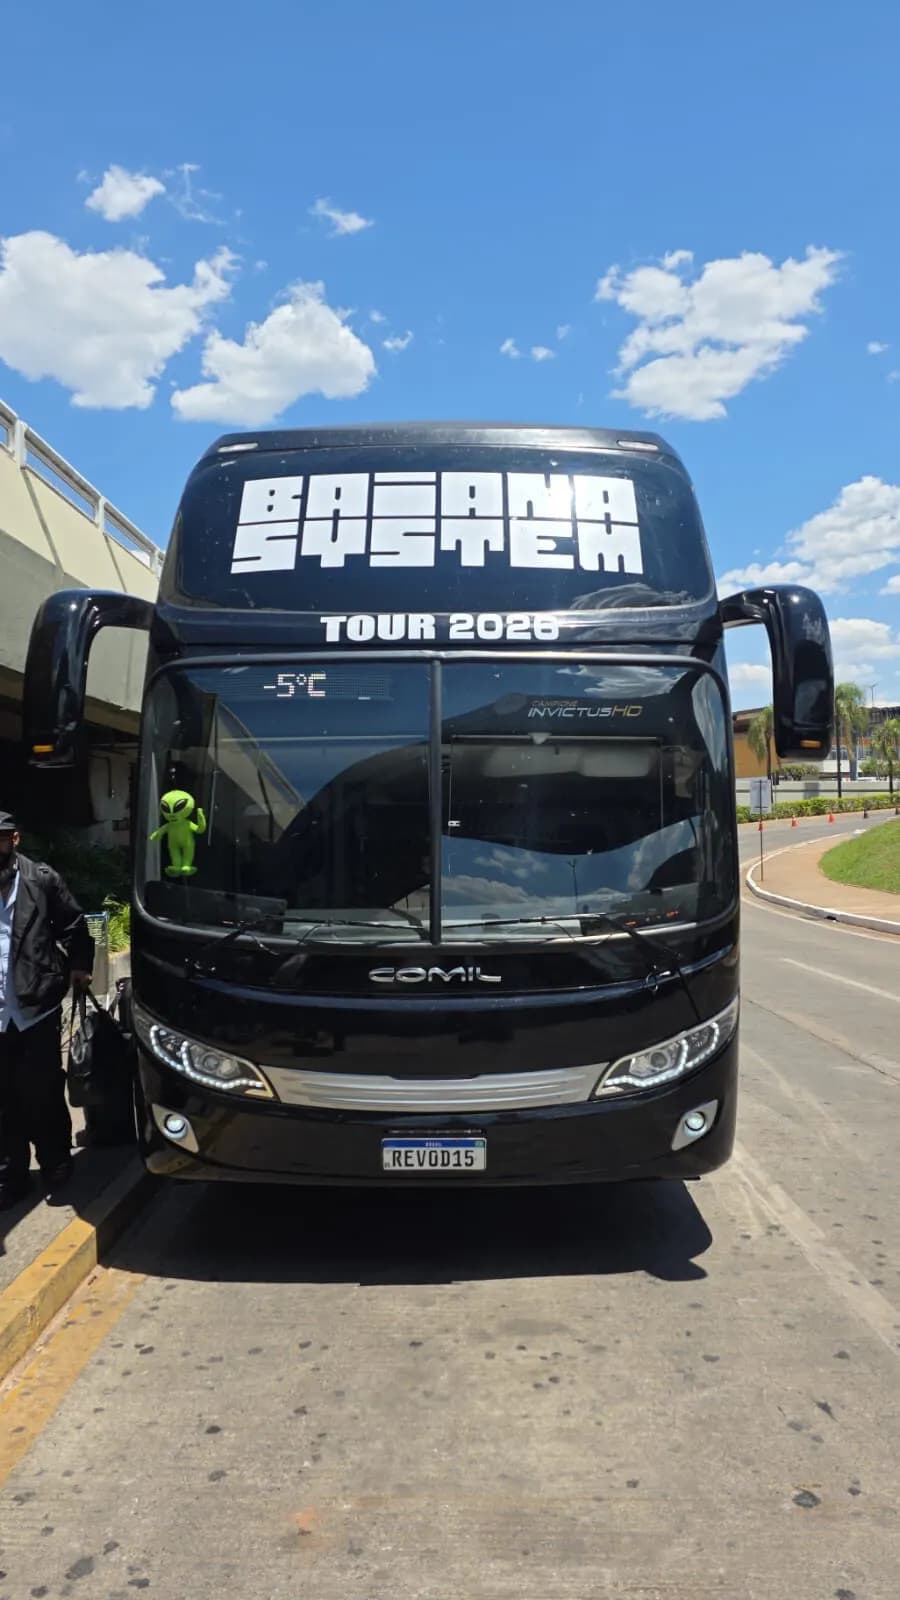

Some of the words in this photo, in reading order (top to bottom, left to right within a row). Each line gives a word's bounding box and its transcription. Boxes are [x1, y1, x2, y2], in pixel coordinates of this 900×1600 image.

[238, 471, 638, 524] BAIANA
[230, 517, 644, 574] SYSTEM
[320, 613, 436, 642] TOUR
[449, 613, 560, 641] 2026
[368, 966, 502, 983] COMIL
